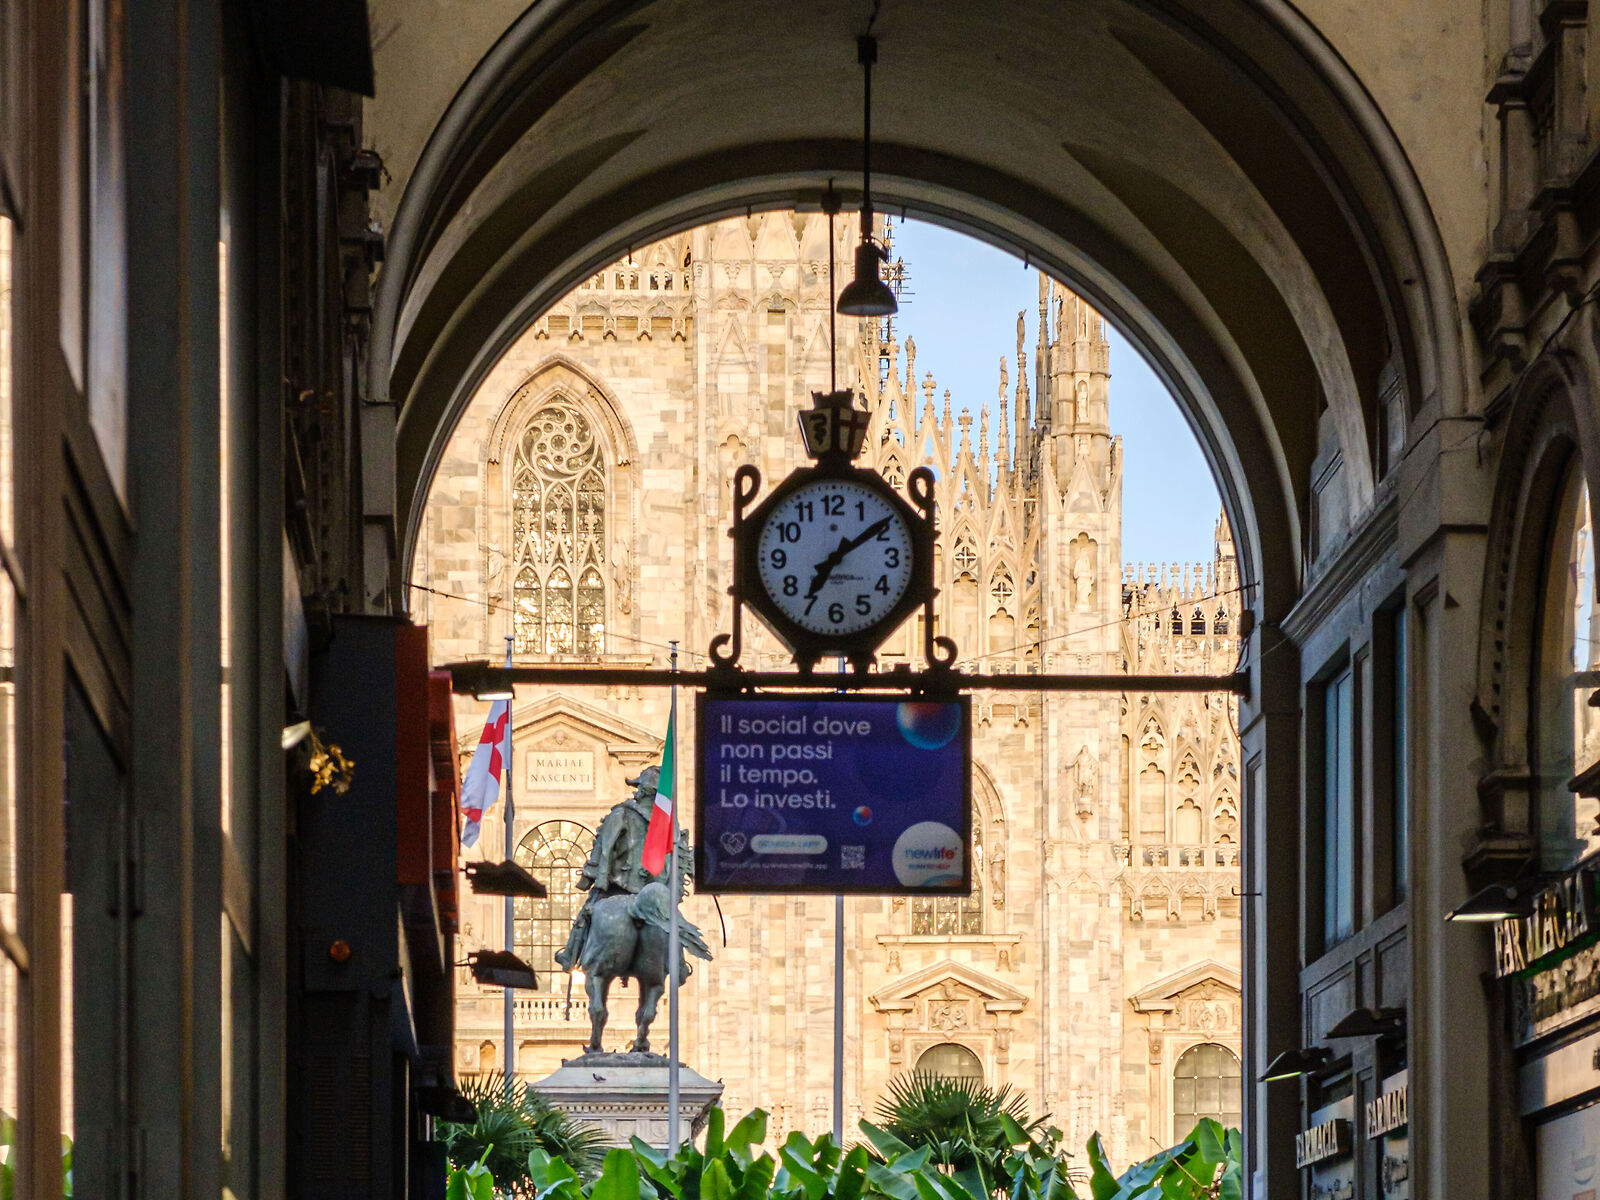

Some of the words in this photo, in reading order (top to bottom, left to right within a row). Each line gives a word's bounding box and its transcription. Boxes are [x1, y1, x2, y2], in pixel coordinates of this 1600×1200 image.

[794, 502, 814, 522] 11
[820, 494, 845, 516] 12
[855, 501, 864, 522] 1
[776, 522, 802, 543] 10
[876, 523, 890, 542] 2
[771, 548, 787, 570] 9
[884, 547, 900, 568] 3
[783, 575, 798, 596] 8
[874, 575, 890, 595] 4
[804, 596, 818, 616] 7
[828, 603, 844, 624] 6
[856, 594, 872, 616] 5
[721, 715, 732, 734] Il
[738, 715, 806, 735] social
[813, 716, 872, 735] dove
[720, 743, 763, 759] non
[771, 740, 833, 764] passi
[536, 758, 585, 768] MARIAE
[530, 774, 591, 783] NASCENTI
[720, 765, 731, 783] il
[740, 767, 818, 788] tempo.
[720, 789, 748, 808] Lo
[755, 789, 836, 808] investi.
[1494, 871, 1588, 979] FARMACIA
[1296, 1119, 1338, 1170] FARMACIA
